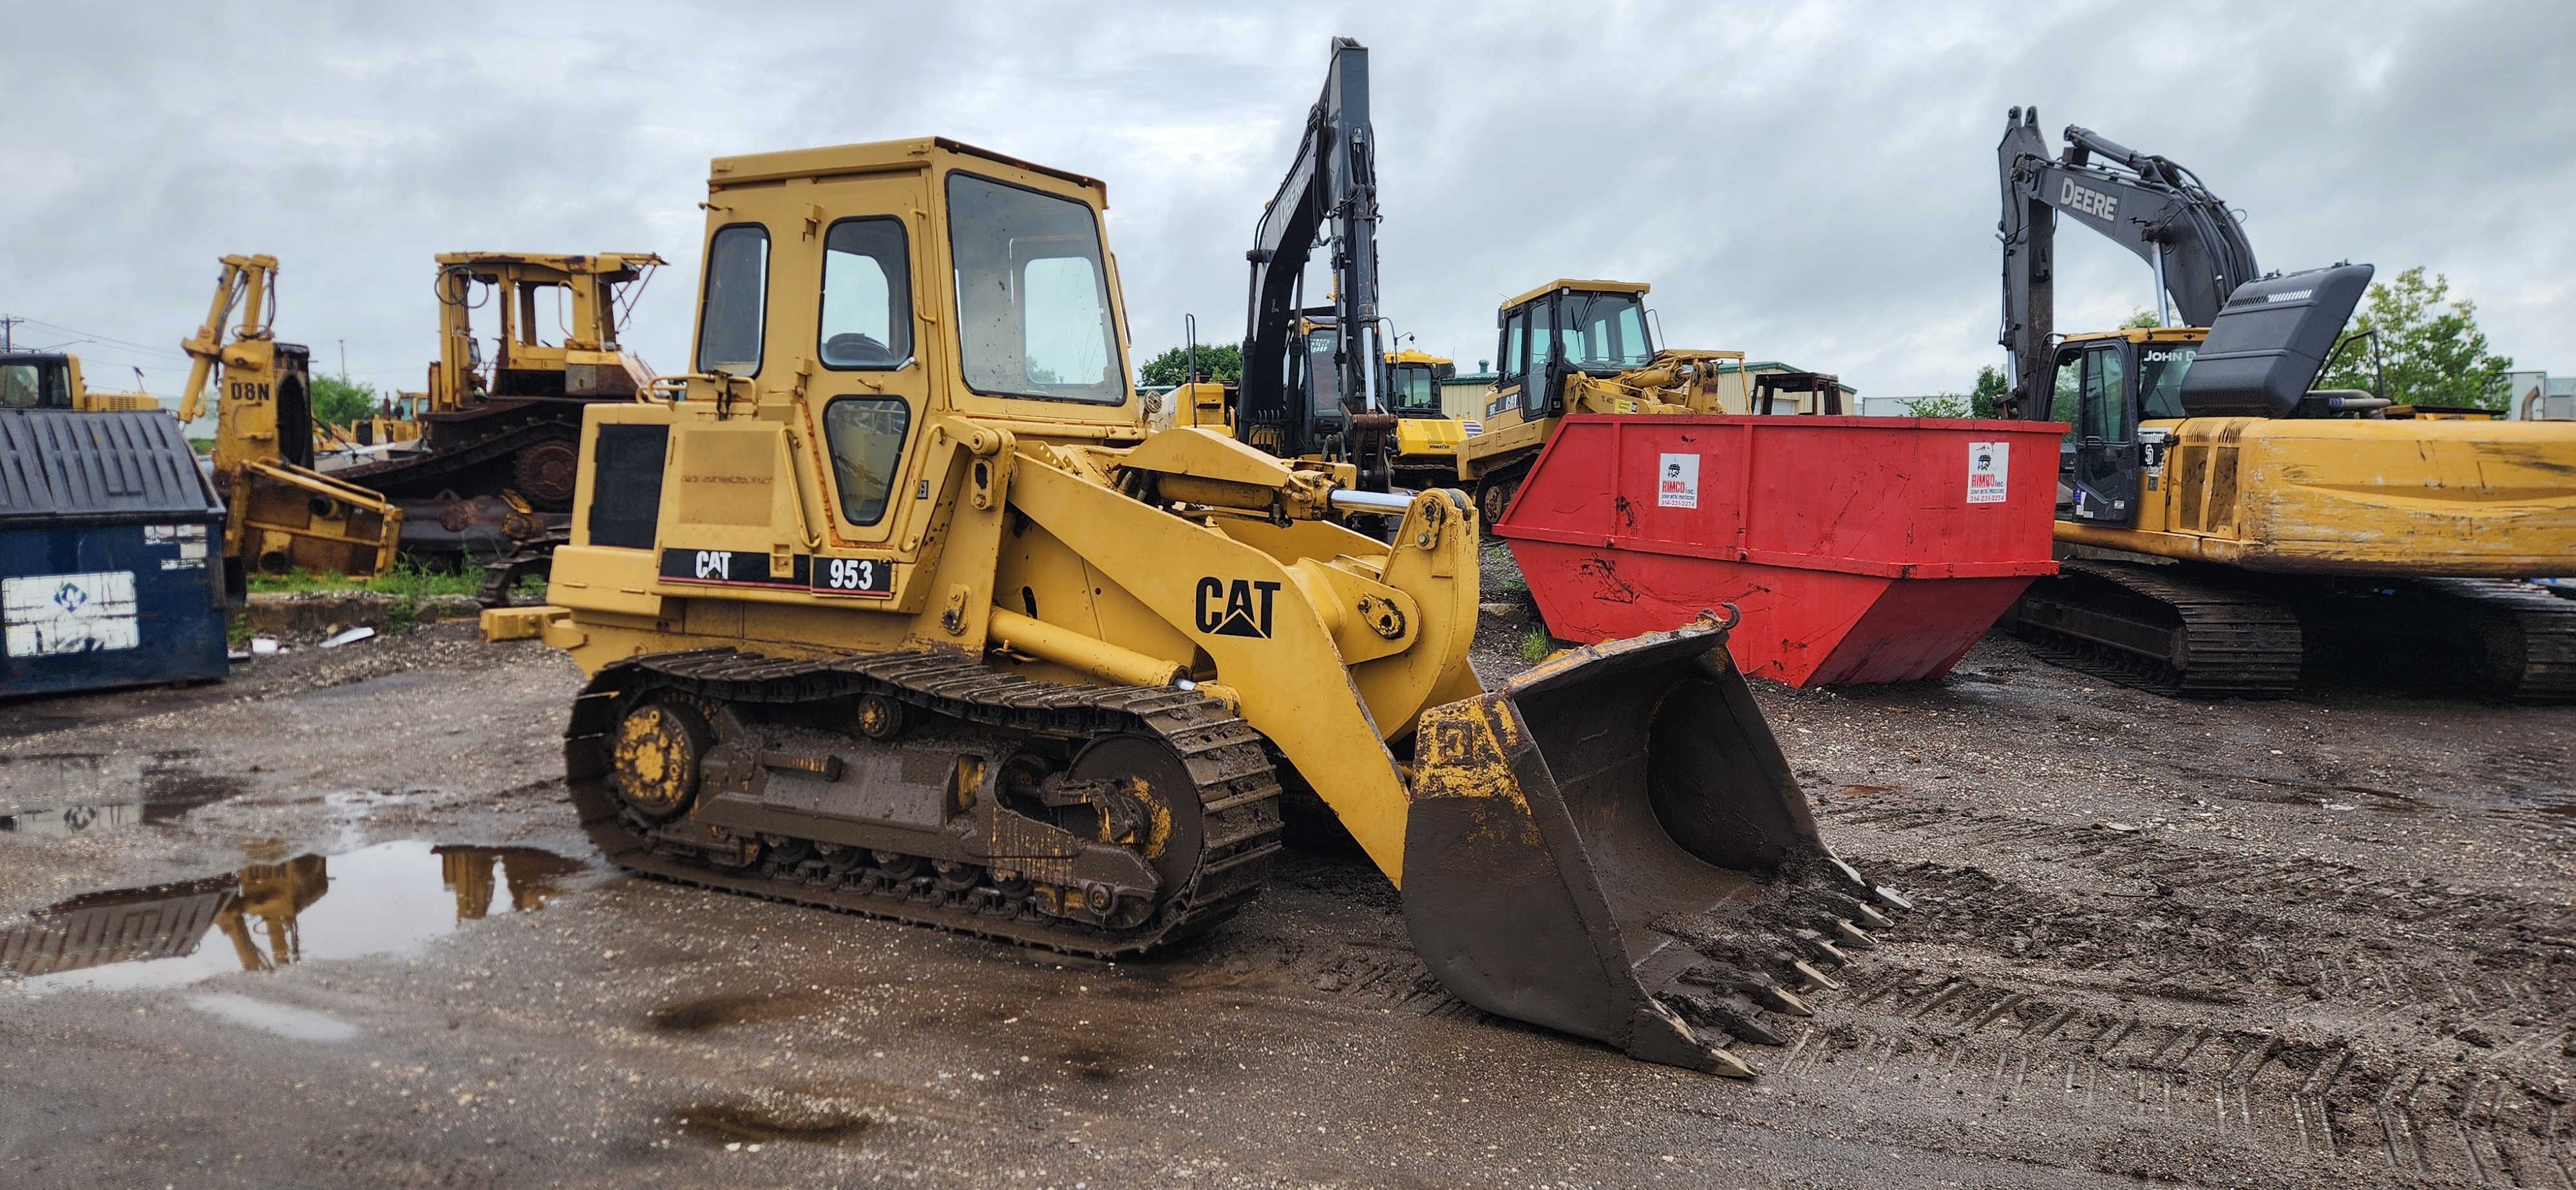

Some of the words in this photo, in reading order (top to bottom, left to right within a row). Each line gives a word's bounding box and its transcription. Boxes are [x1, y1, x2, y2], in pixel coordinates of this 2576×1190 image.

[1280, 165, 1305, 228] DEERE
[2060, 176, 2117, 222] DEERE
[2143, 350, 2183, 361] JOHN
[231, 382, 269, 401] D8N
[1506, 393, 1518, 410] CAT
[1662, 480, 1685, 493] RIMCO
[1971, 475, 1994, 487] RIMCO
[696, 551, 732, 580] CAT
[829, 559, 873, 590] 953
[1195, 576, 1281, 639] CAT
